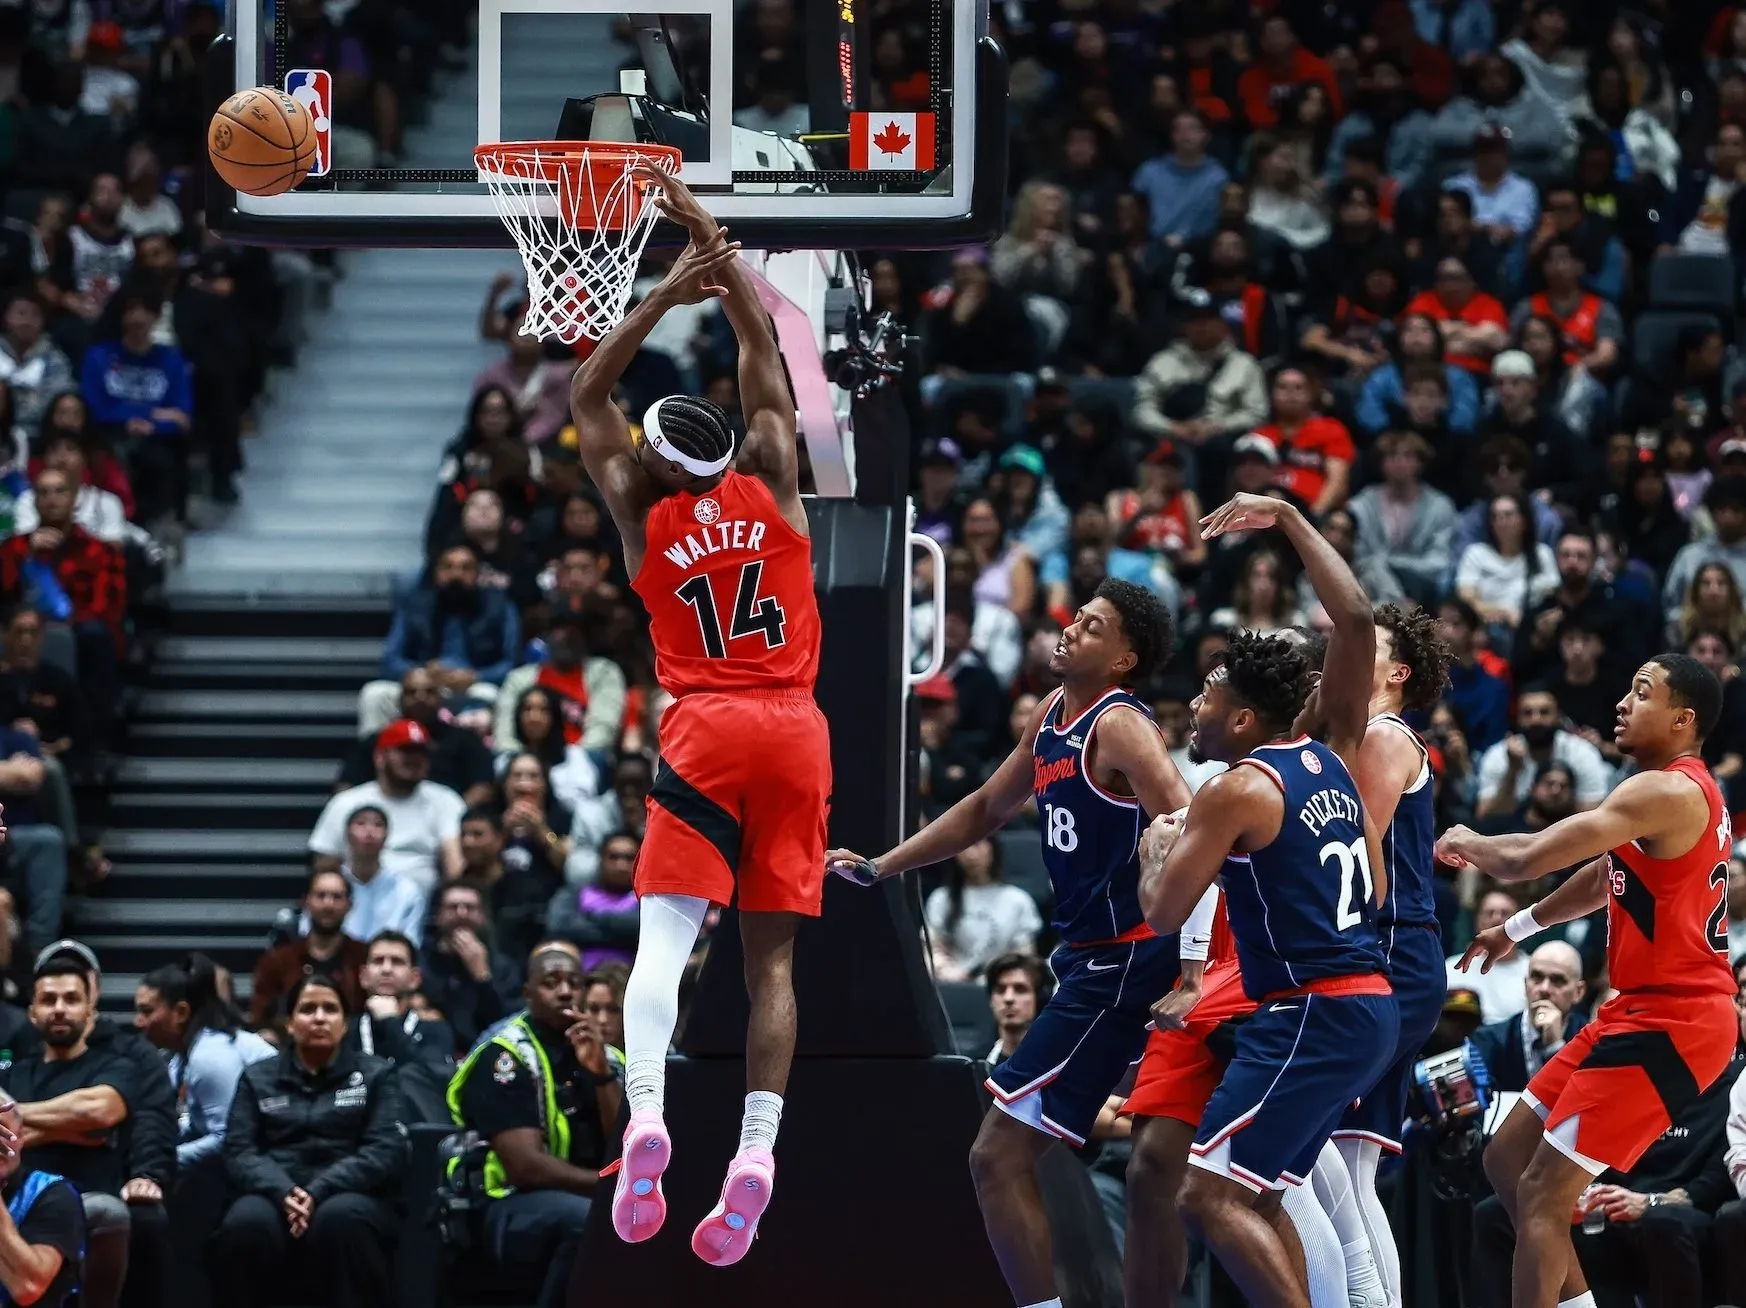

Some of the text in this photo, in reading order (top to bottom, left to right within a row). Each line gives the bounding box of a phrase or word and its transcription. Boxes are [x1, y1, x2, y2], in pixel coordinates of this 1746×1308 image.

[663, 520, 767, 570] WALTER
[674, 560, 786, 659] 14
[1034, 755, 1076, 797] lippers
[1045, 803, 1078, 853] 18
[1319, 836, 1373, 932] 21
[1660, 1125, 1690, 1141] CHY
